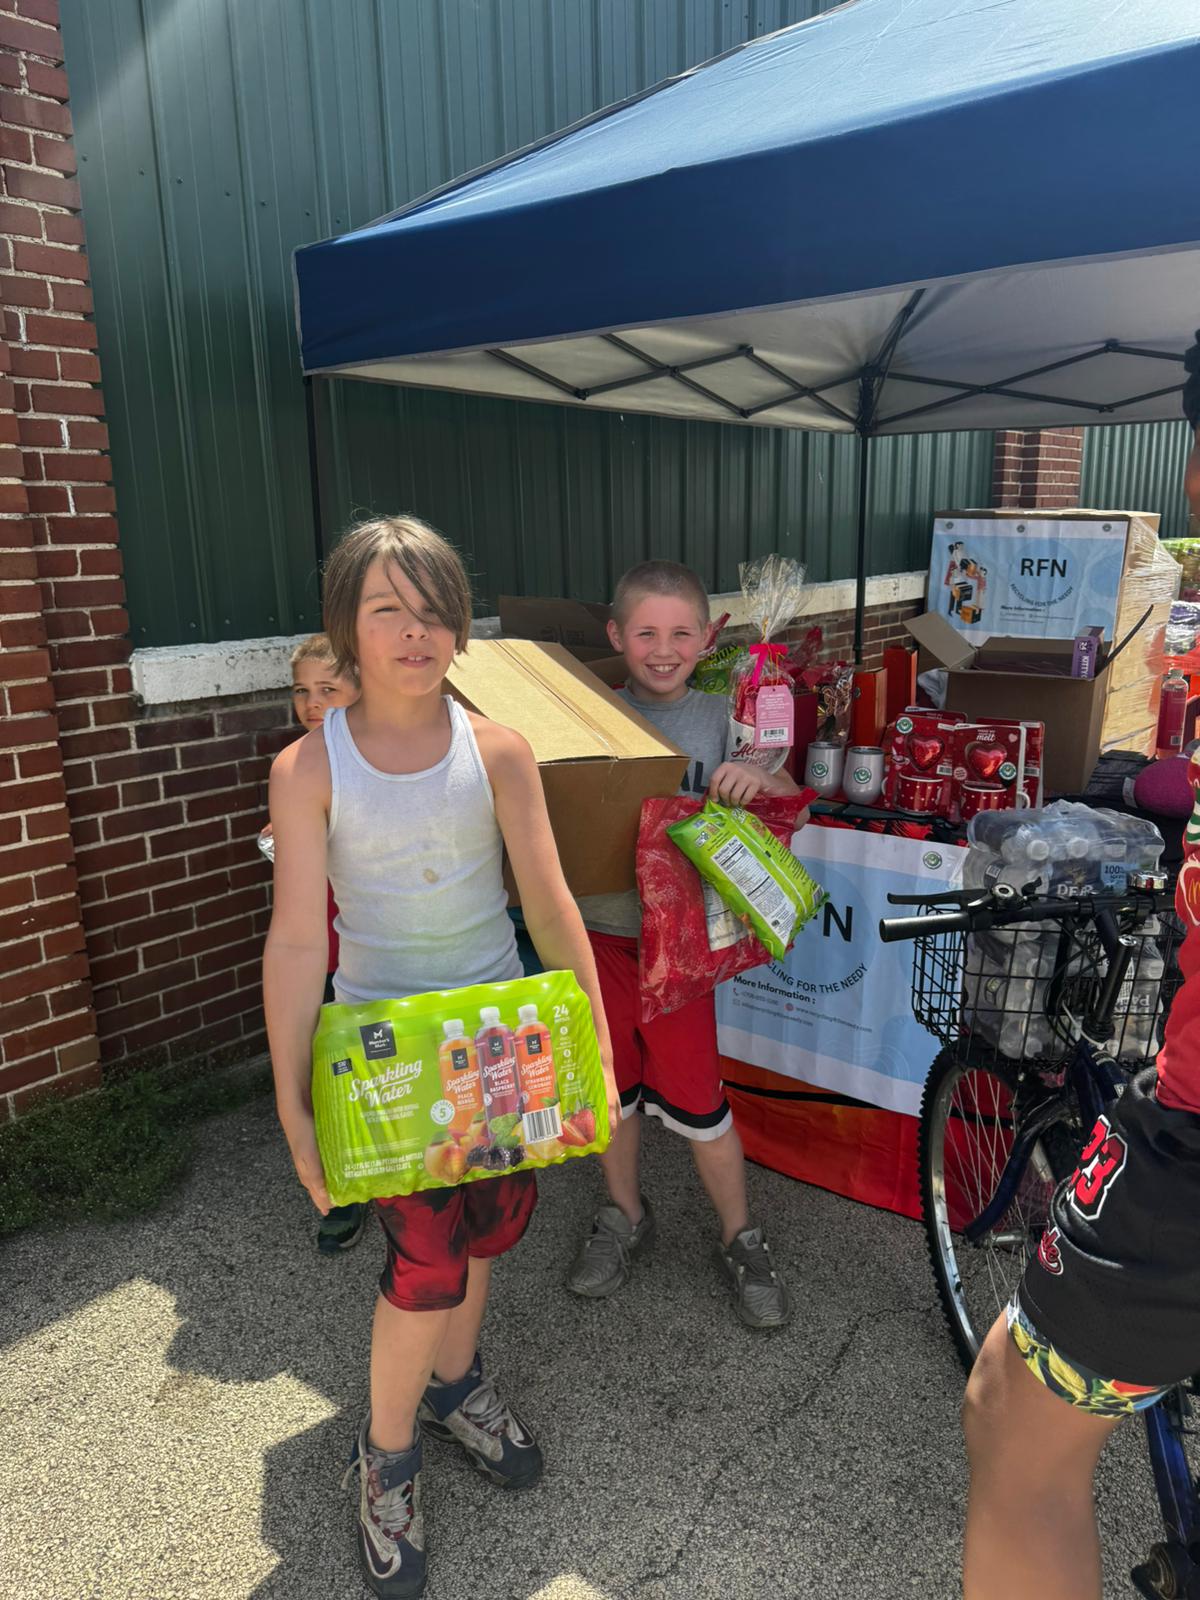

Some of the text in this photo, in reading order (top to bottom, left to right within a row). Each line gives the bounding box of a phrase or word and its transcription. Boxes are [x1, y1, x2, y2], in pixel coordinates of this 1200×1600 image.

[1020, 557, 1067, 578] RFN
[733, 975, 757, 989] More
[757, 980, 811, 1003] Information
[796, 980, 817, 994] FOR
[819, 982, 841, 994] THE
[840, 961, 869, 991] NEEDY
[552, 1003, 570, 1018] 24
[348, 1059, 423, 1102] Sparkling
[365, 1083, 414, 1108] Water
